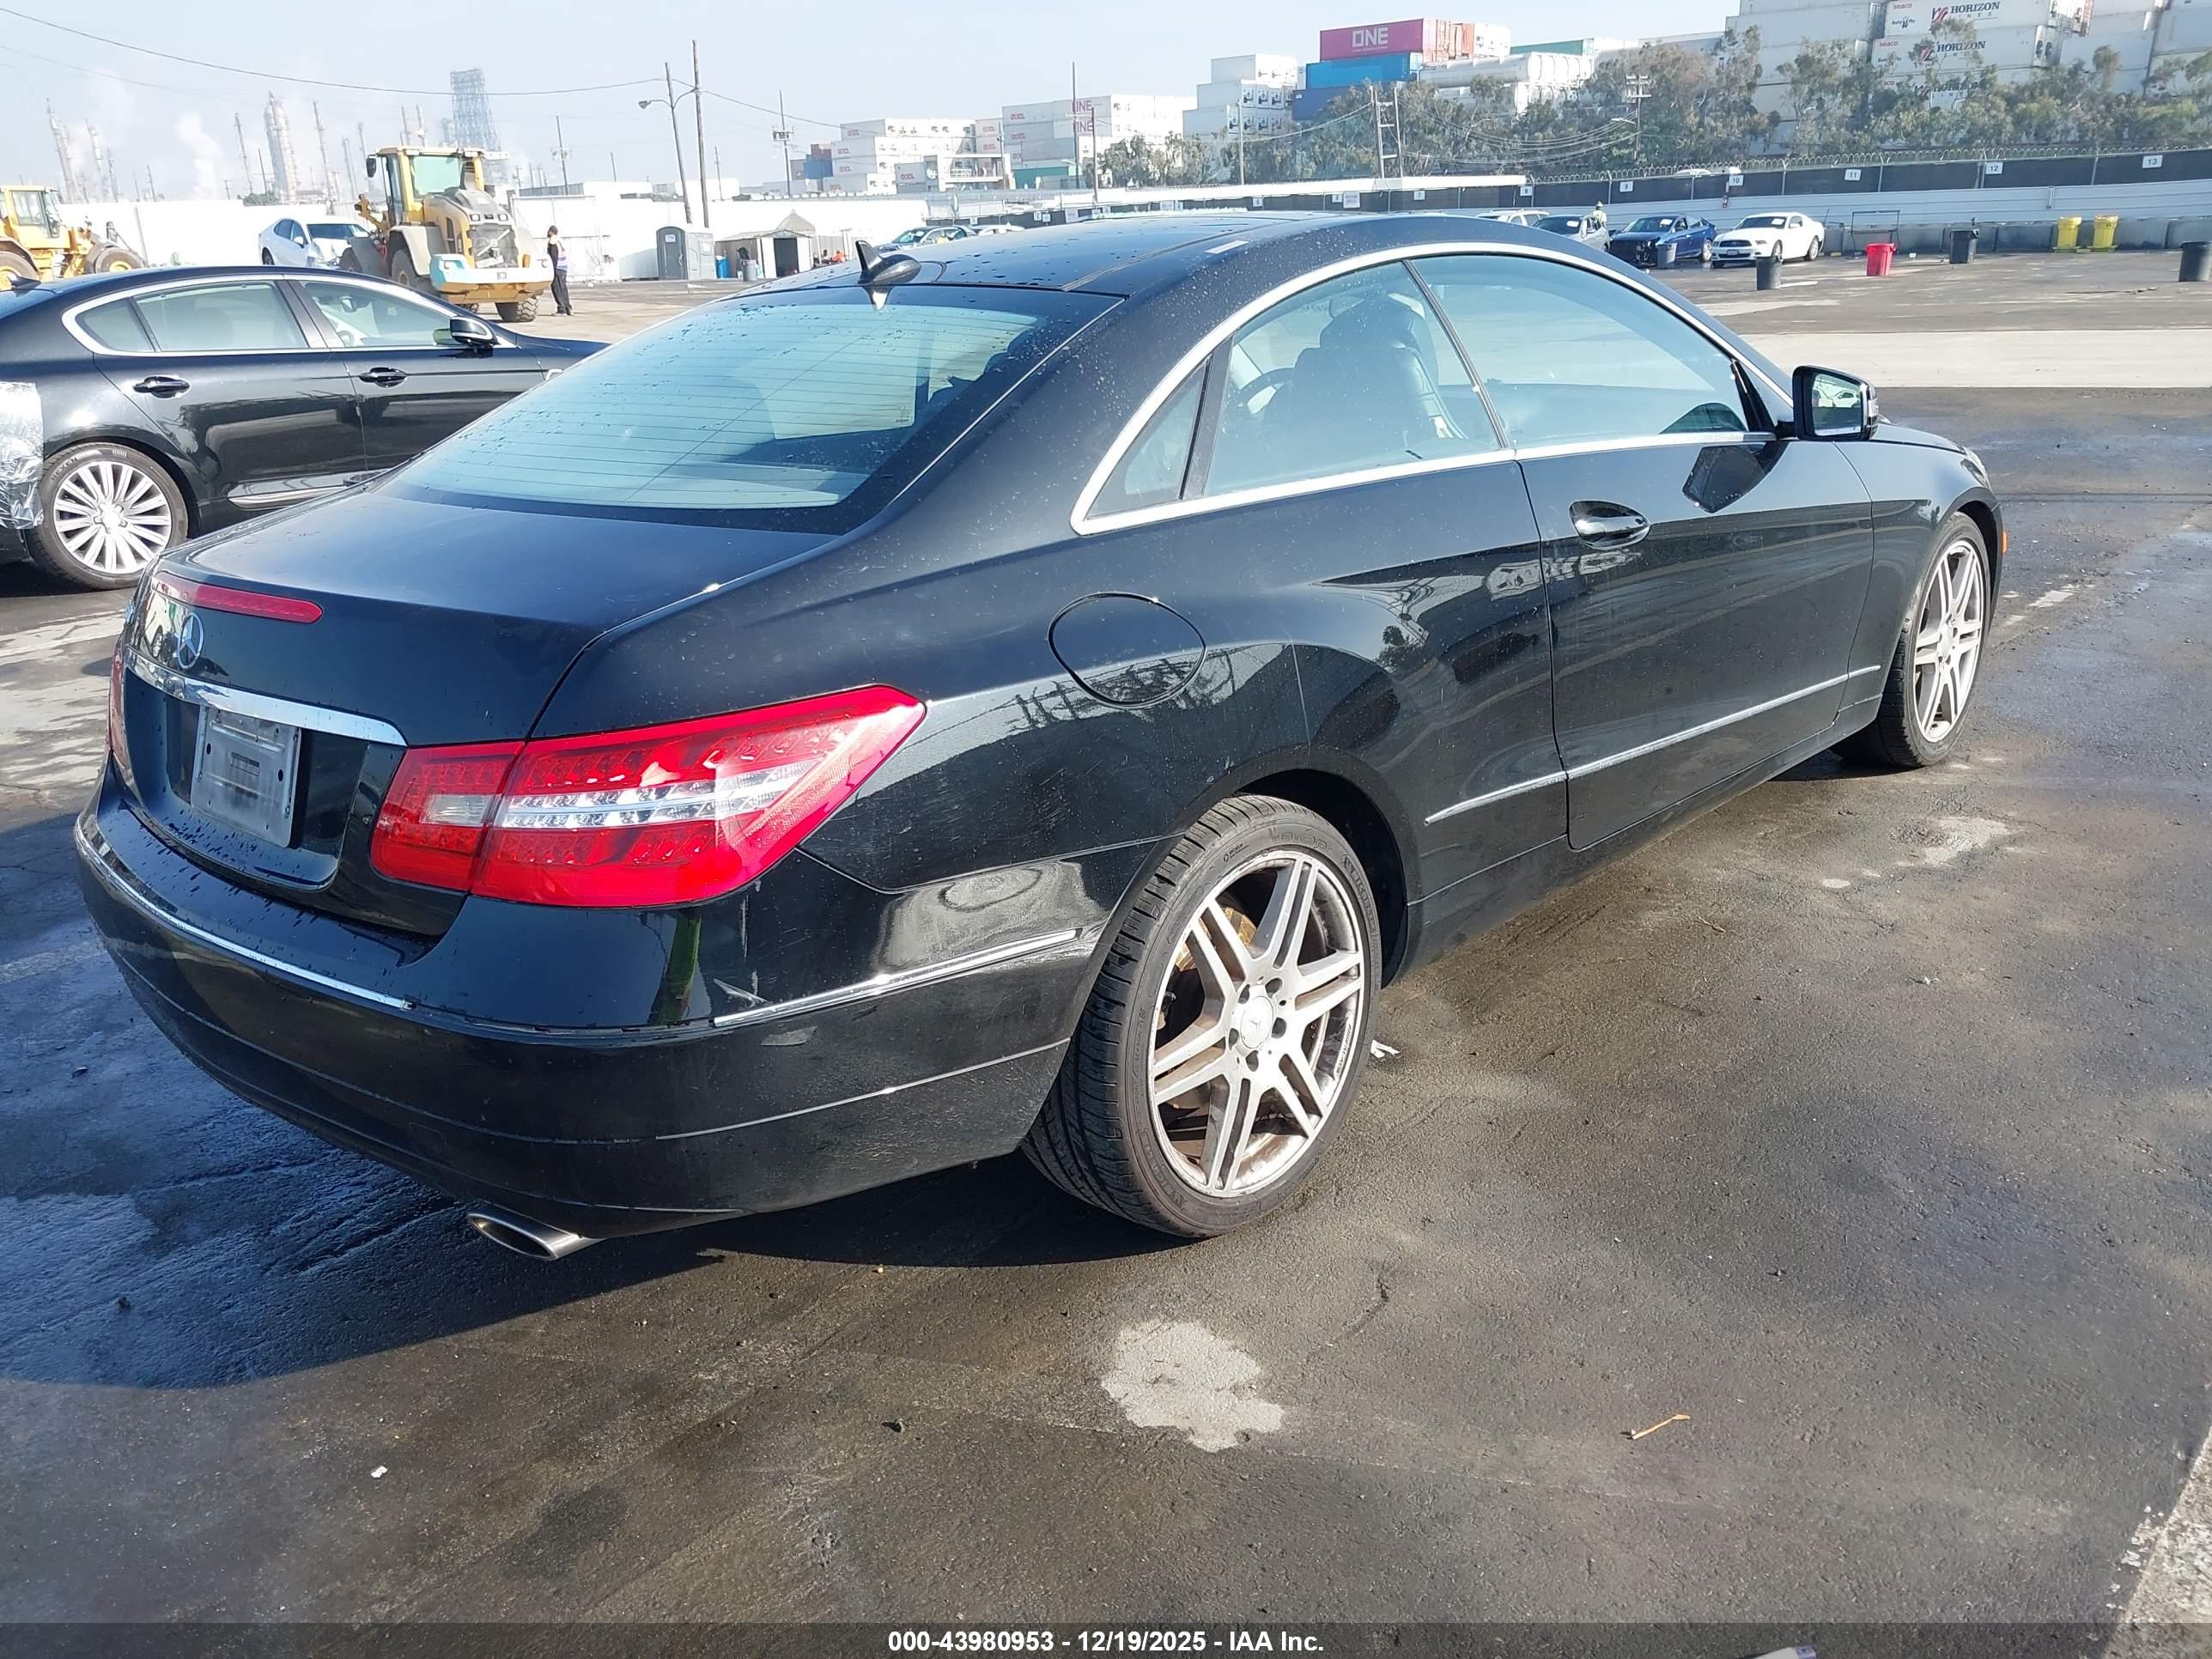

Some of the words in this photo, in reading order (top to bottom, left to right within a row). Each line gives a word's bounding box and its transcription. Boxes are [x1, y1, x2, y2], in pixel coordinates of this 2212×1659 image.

[1950, 1, 2001, 14] HORIZON
[1352, 27, 1389, 48] ONE
[1936, 40, 1986, 52] HORIZON
